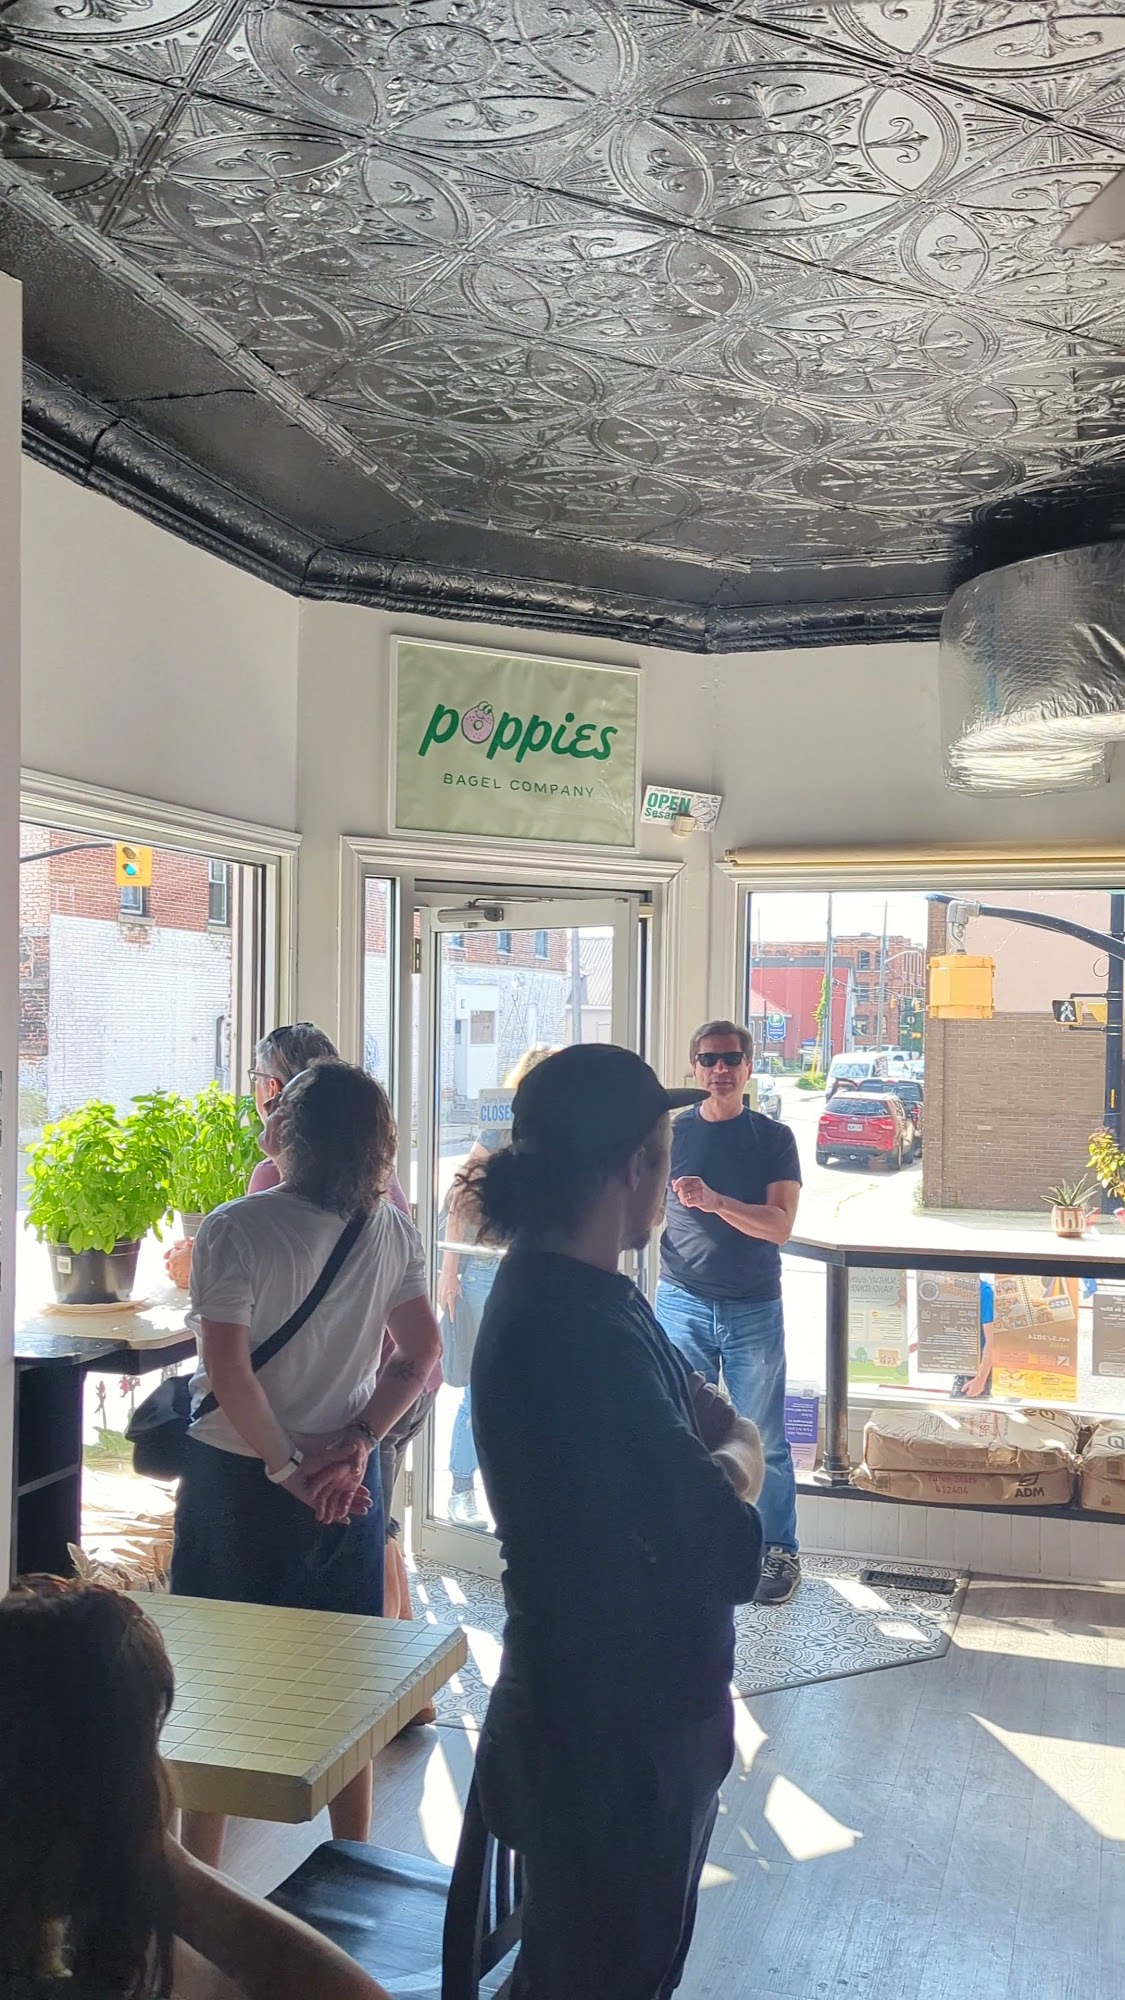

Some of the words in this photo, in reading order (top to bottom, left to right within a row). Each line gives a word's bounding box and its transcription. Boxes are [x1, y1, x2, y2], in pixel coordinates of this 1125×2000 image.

[418, 701, 618, 763] poppies
[443, 772, 502, 789] BAGEL
[509, 779, 594, 798] COMPANY
[647, 792, 692, 813] OPEN
[481, 1105, 513, 1122] CLOSE
[1014, 1486, 1045, 1499] ADM
